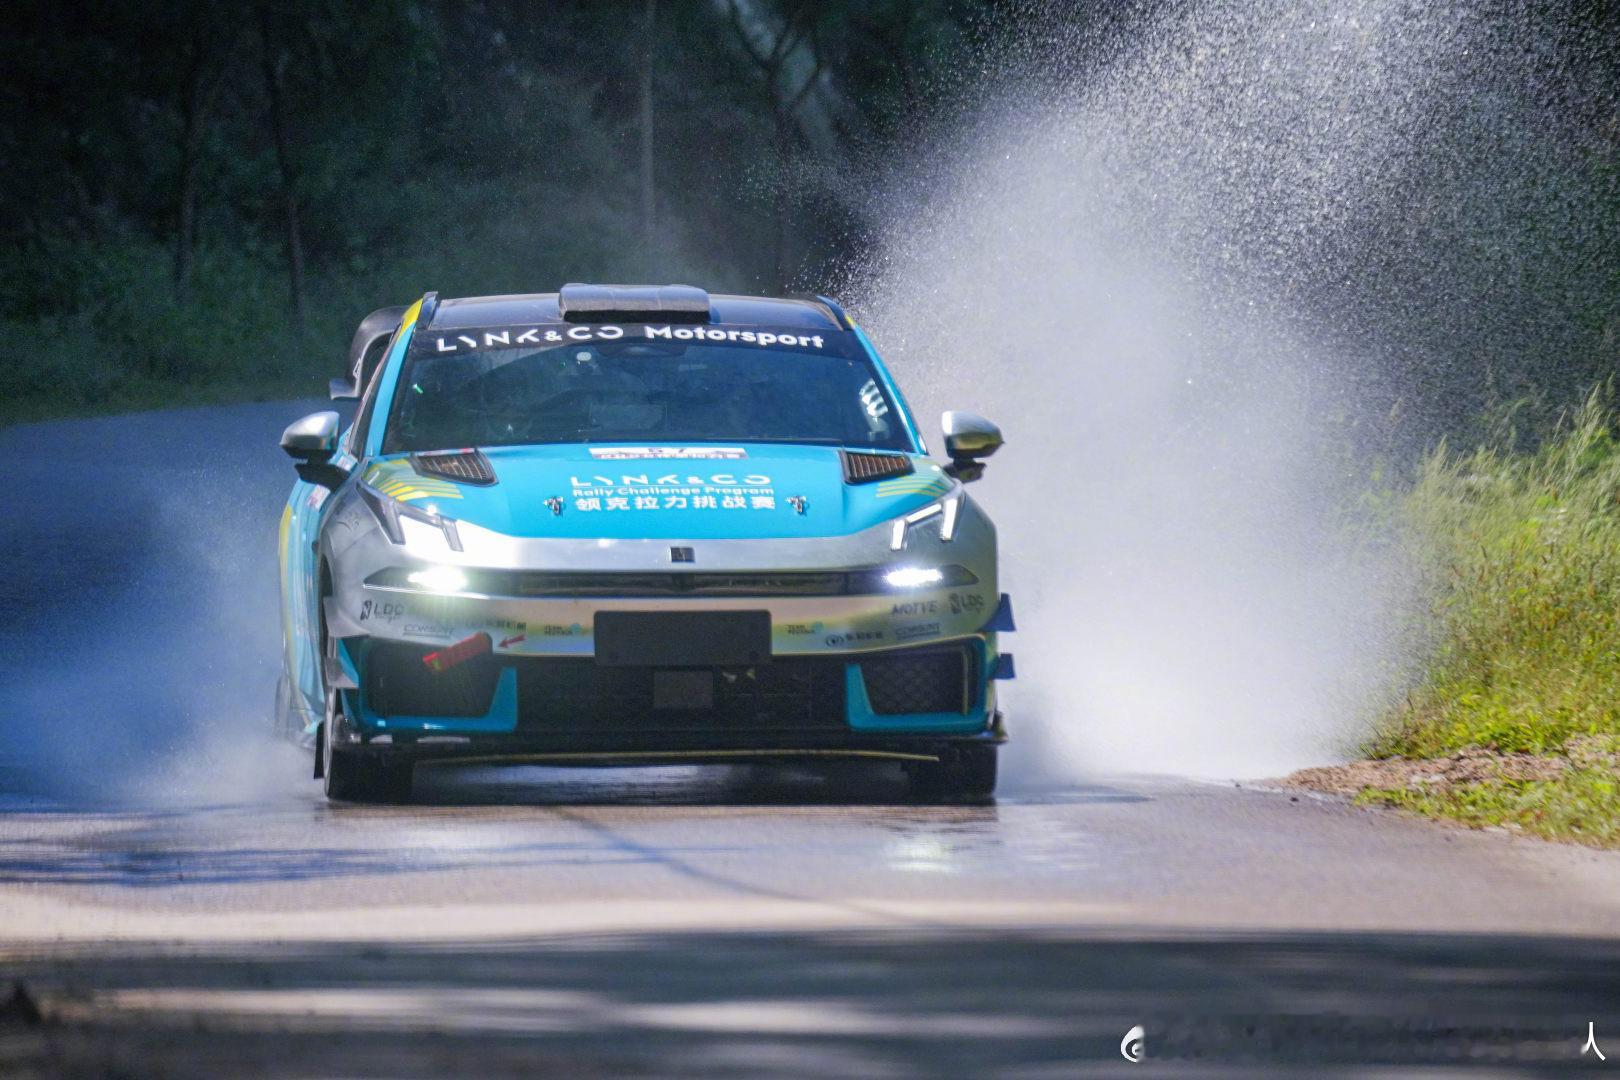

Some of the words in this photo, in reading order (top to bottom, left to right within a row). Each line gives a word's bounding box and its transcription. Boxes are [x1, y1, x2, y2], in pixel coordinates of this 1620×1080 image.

[643, 325, 825, 348] Motorsport
[572, 488, 614, 497] Rally
[617, 486, 701, 496] Challenge
[703, 486, 774, 495] Program
[576, 496, 775, 511] 领克拉力挑战赛
